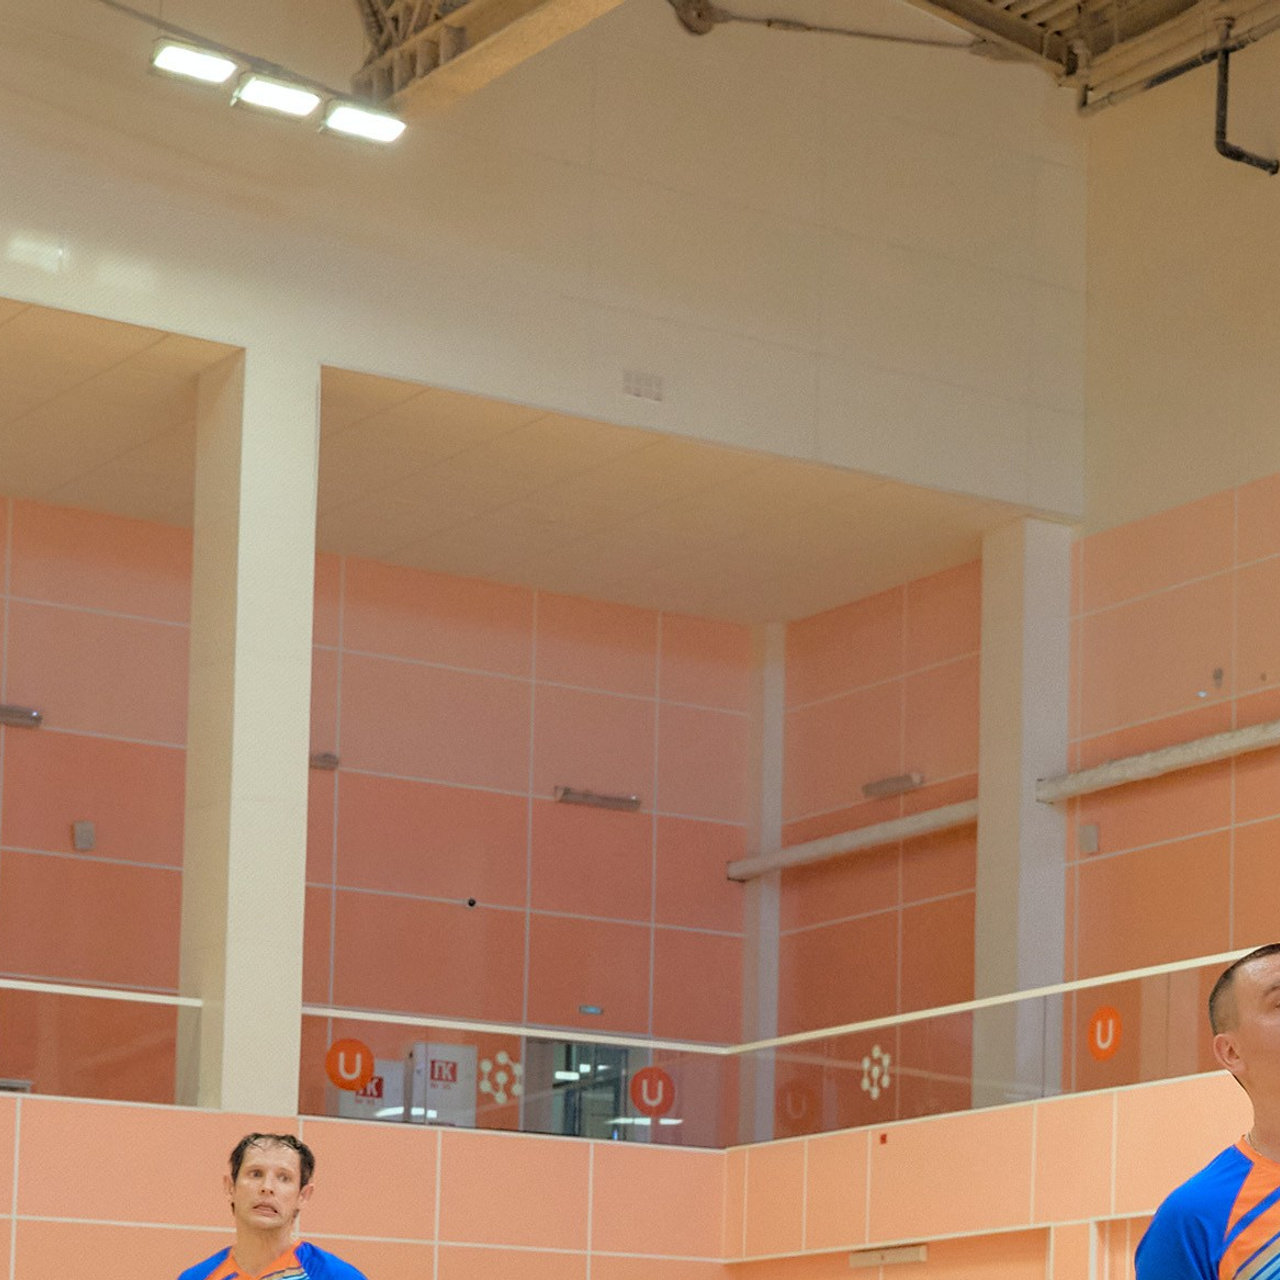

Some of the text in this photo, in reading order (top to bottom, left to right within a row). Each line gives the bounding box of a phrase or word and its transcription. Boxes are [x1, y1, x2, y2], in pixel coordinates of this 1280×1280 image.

[1096, 1018, 1113, 1050] U
[338, 1052, 362, 1080] U
[641, 1079, 662, 1106] U
